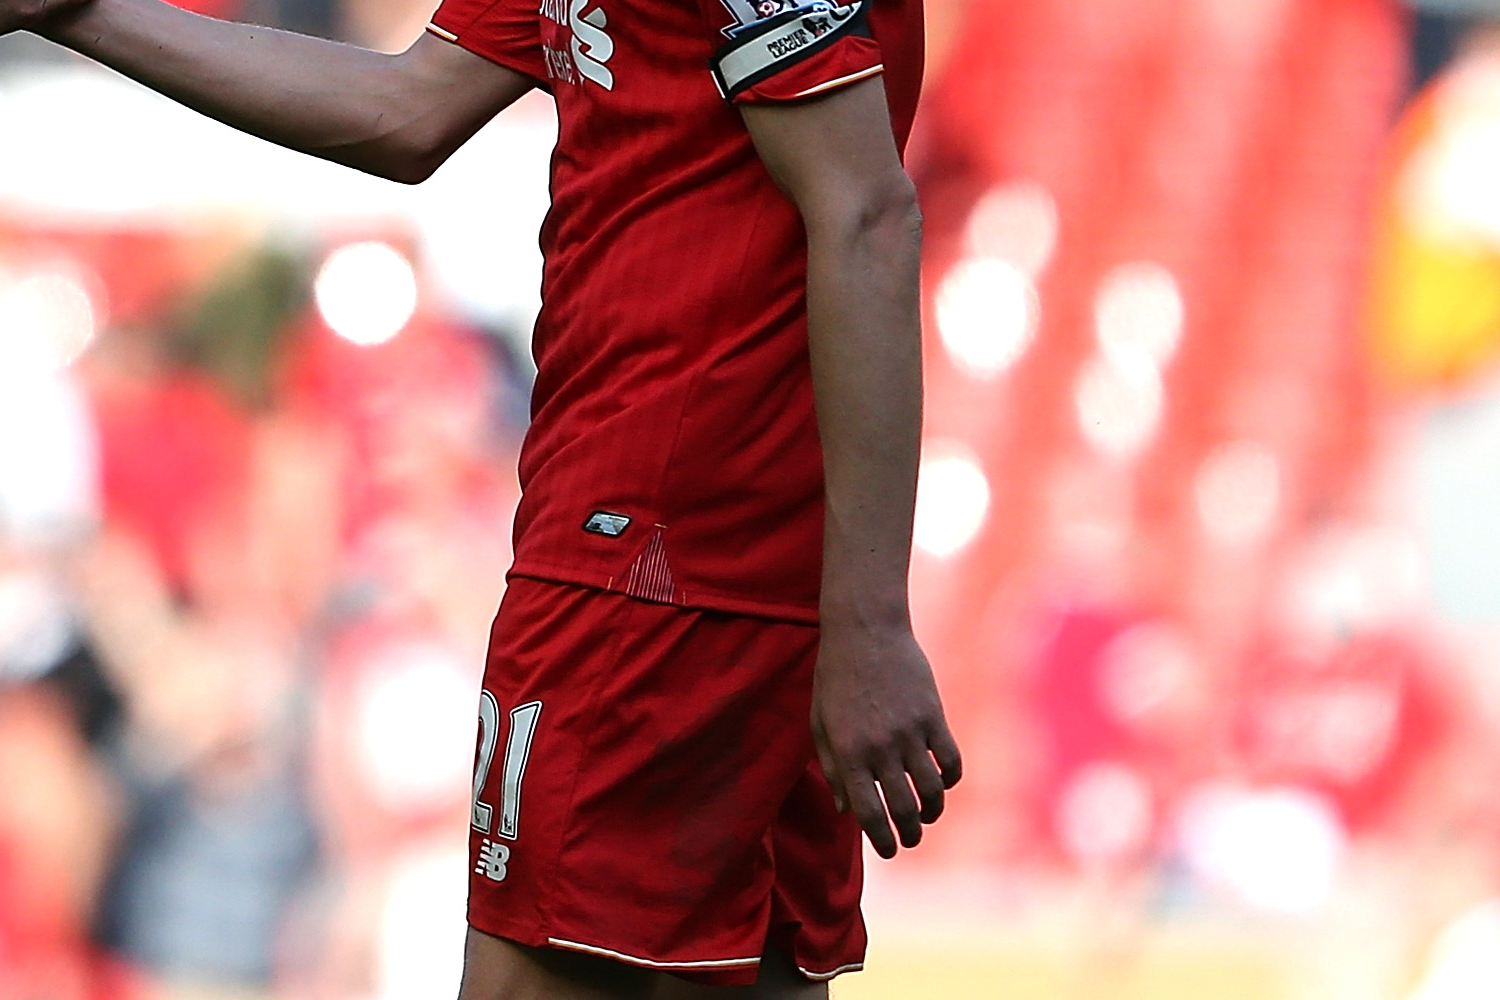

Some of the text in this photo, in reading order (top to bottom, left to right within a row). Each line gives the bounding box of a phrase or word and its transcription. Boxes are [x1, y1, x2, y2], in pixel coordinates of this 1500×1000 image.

[767, 29, 807, 52] PREMIER
[772, 36, 809, 59] LEAGUE
[471, 689, 543, 840] 21
